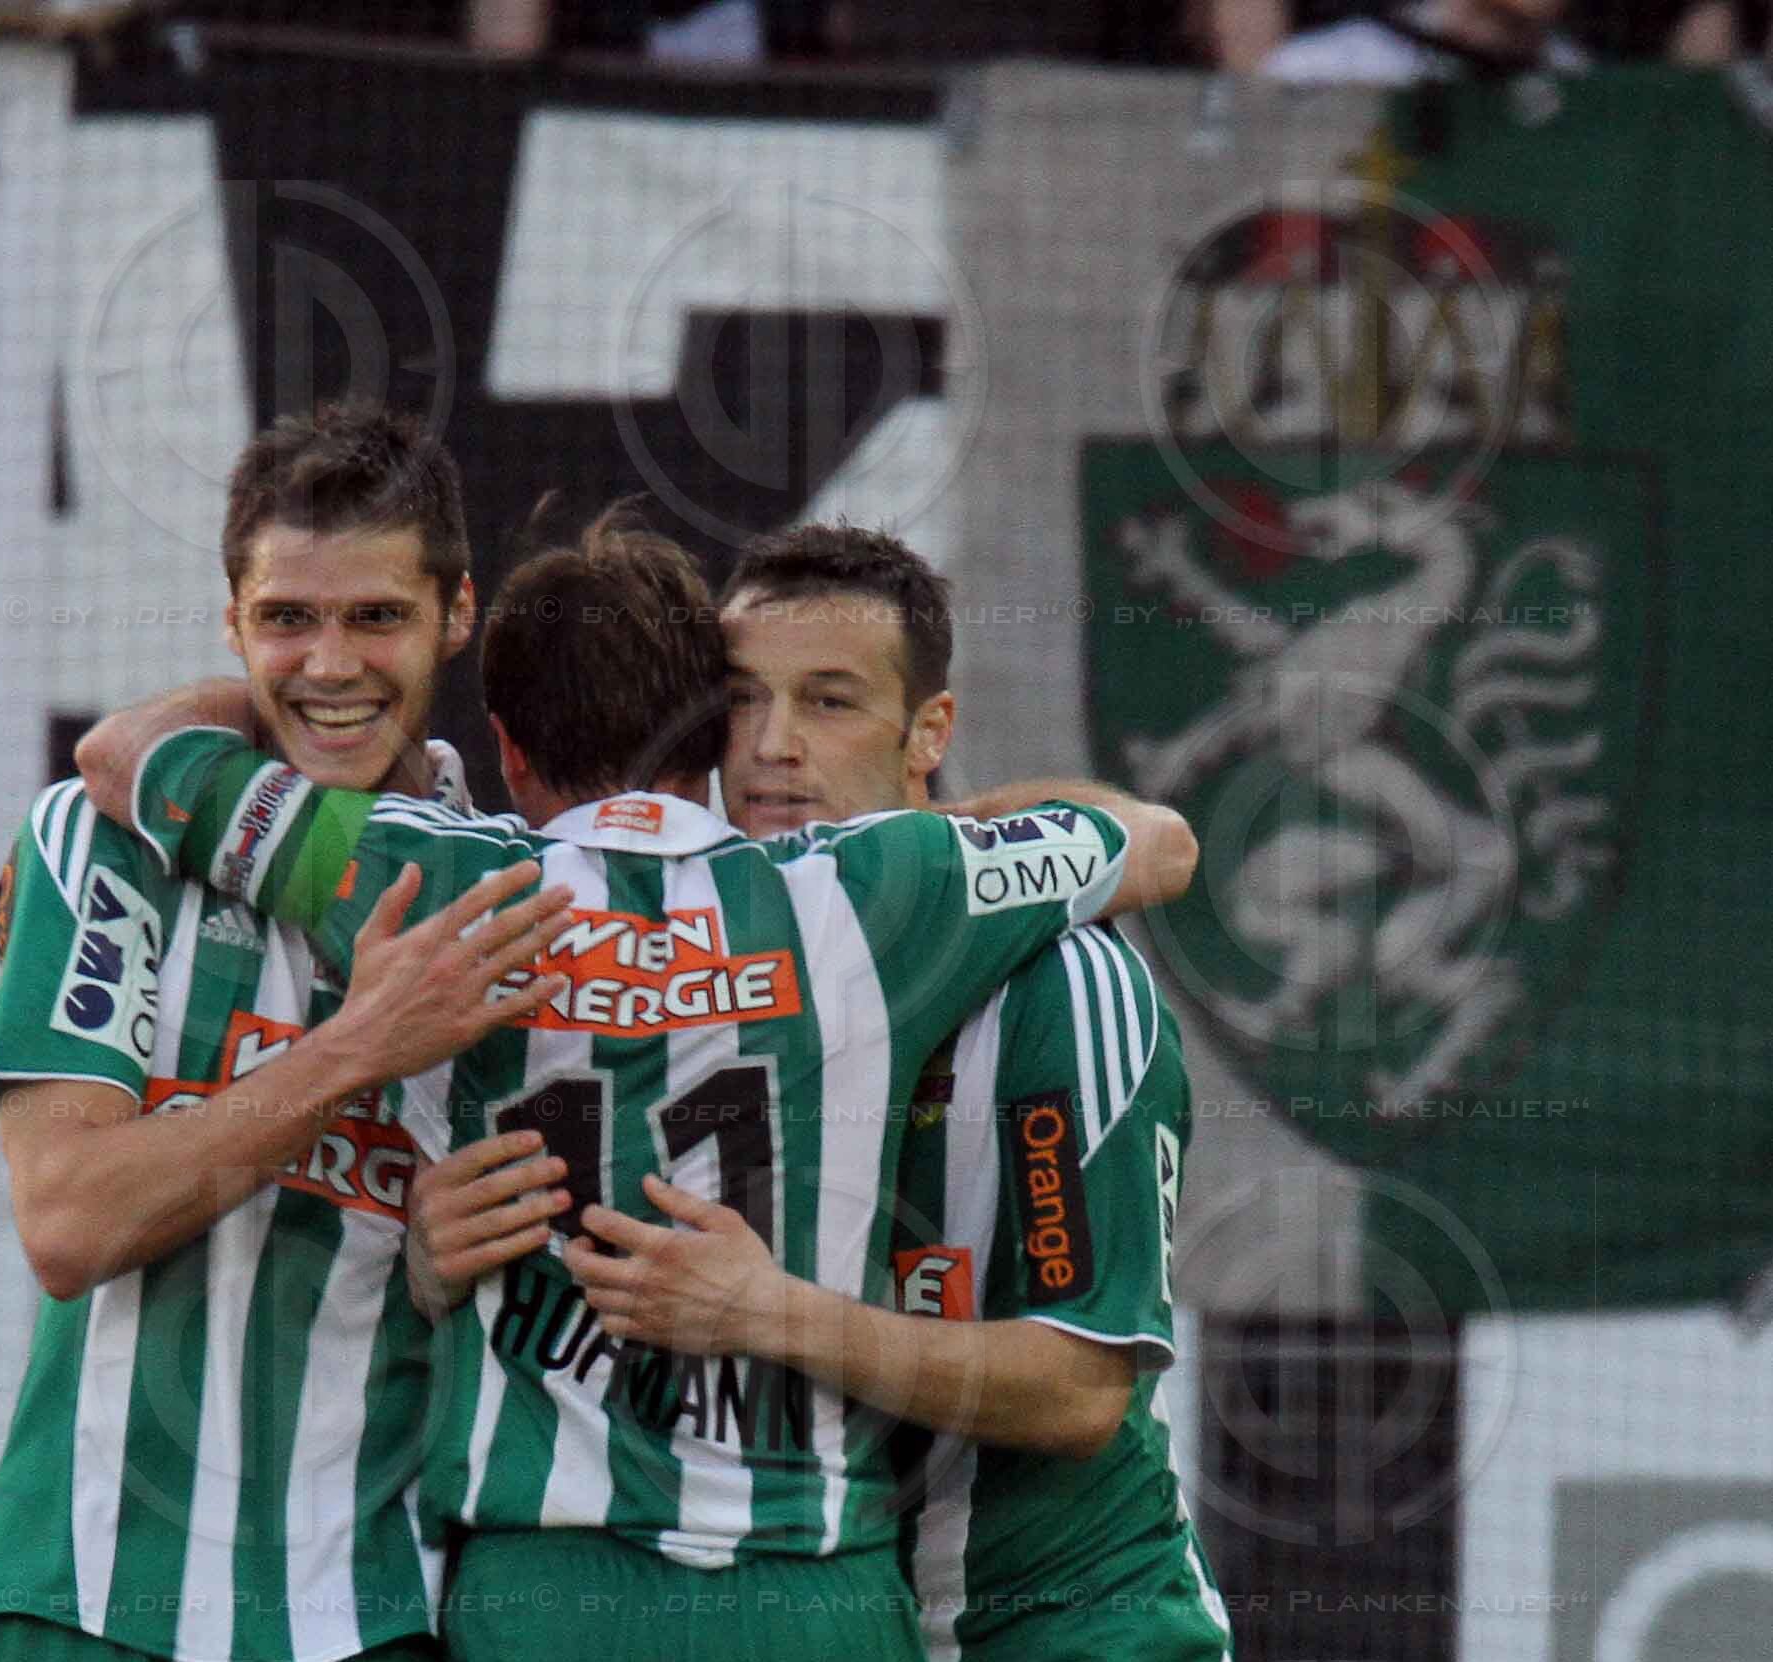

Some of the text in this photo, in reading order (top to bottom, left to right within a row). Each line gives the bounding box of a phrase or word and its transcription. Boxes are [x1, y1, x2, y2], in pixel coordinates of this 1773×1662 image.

[976, 853, 1097, 903] OMV
[489, 1056, 785, 1262] 11
[1022, 1106, 1075, 1289] Orange
